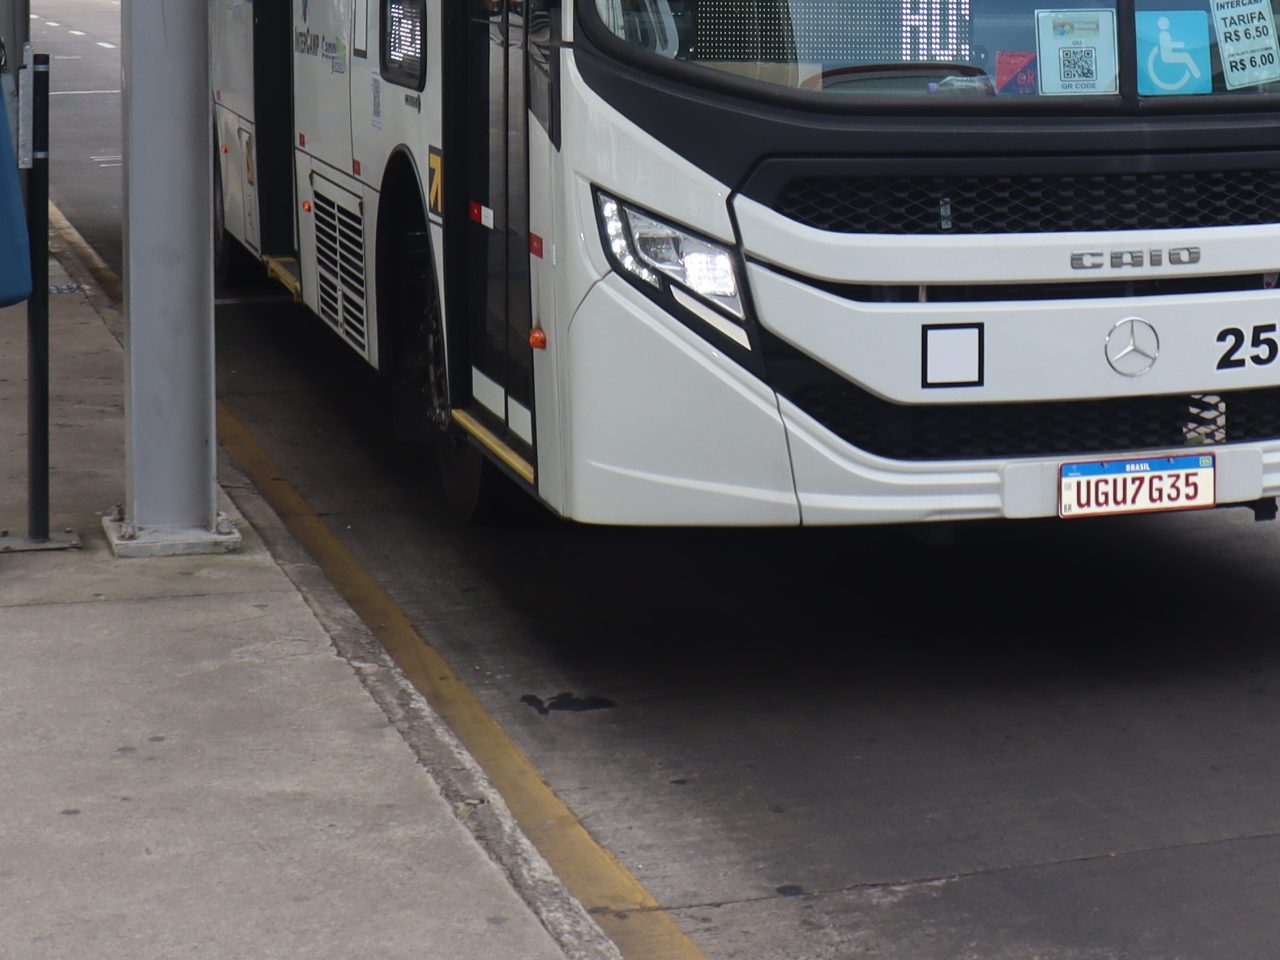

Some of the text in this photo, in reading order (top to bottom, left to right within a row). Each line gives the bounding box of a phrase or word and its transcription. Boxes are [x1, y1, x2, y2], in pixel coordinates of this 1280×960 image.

[1221, 10, 1267, 29] TARIFA
[1224, 24, 1270, 43] R$ 6,50
[1229, 58, 1247, 73] R$
[1249, 52, 1275, 69] 6,00
[1069, 246, 1202, 270] CAIO
[1125, 462, 1151, 473] BRASIL
[1075, 471, 1200, 509] UGU7G35
